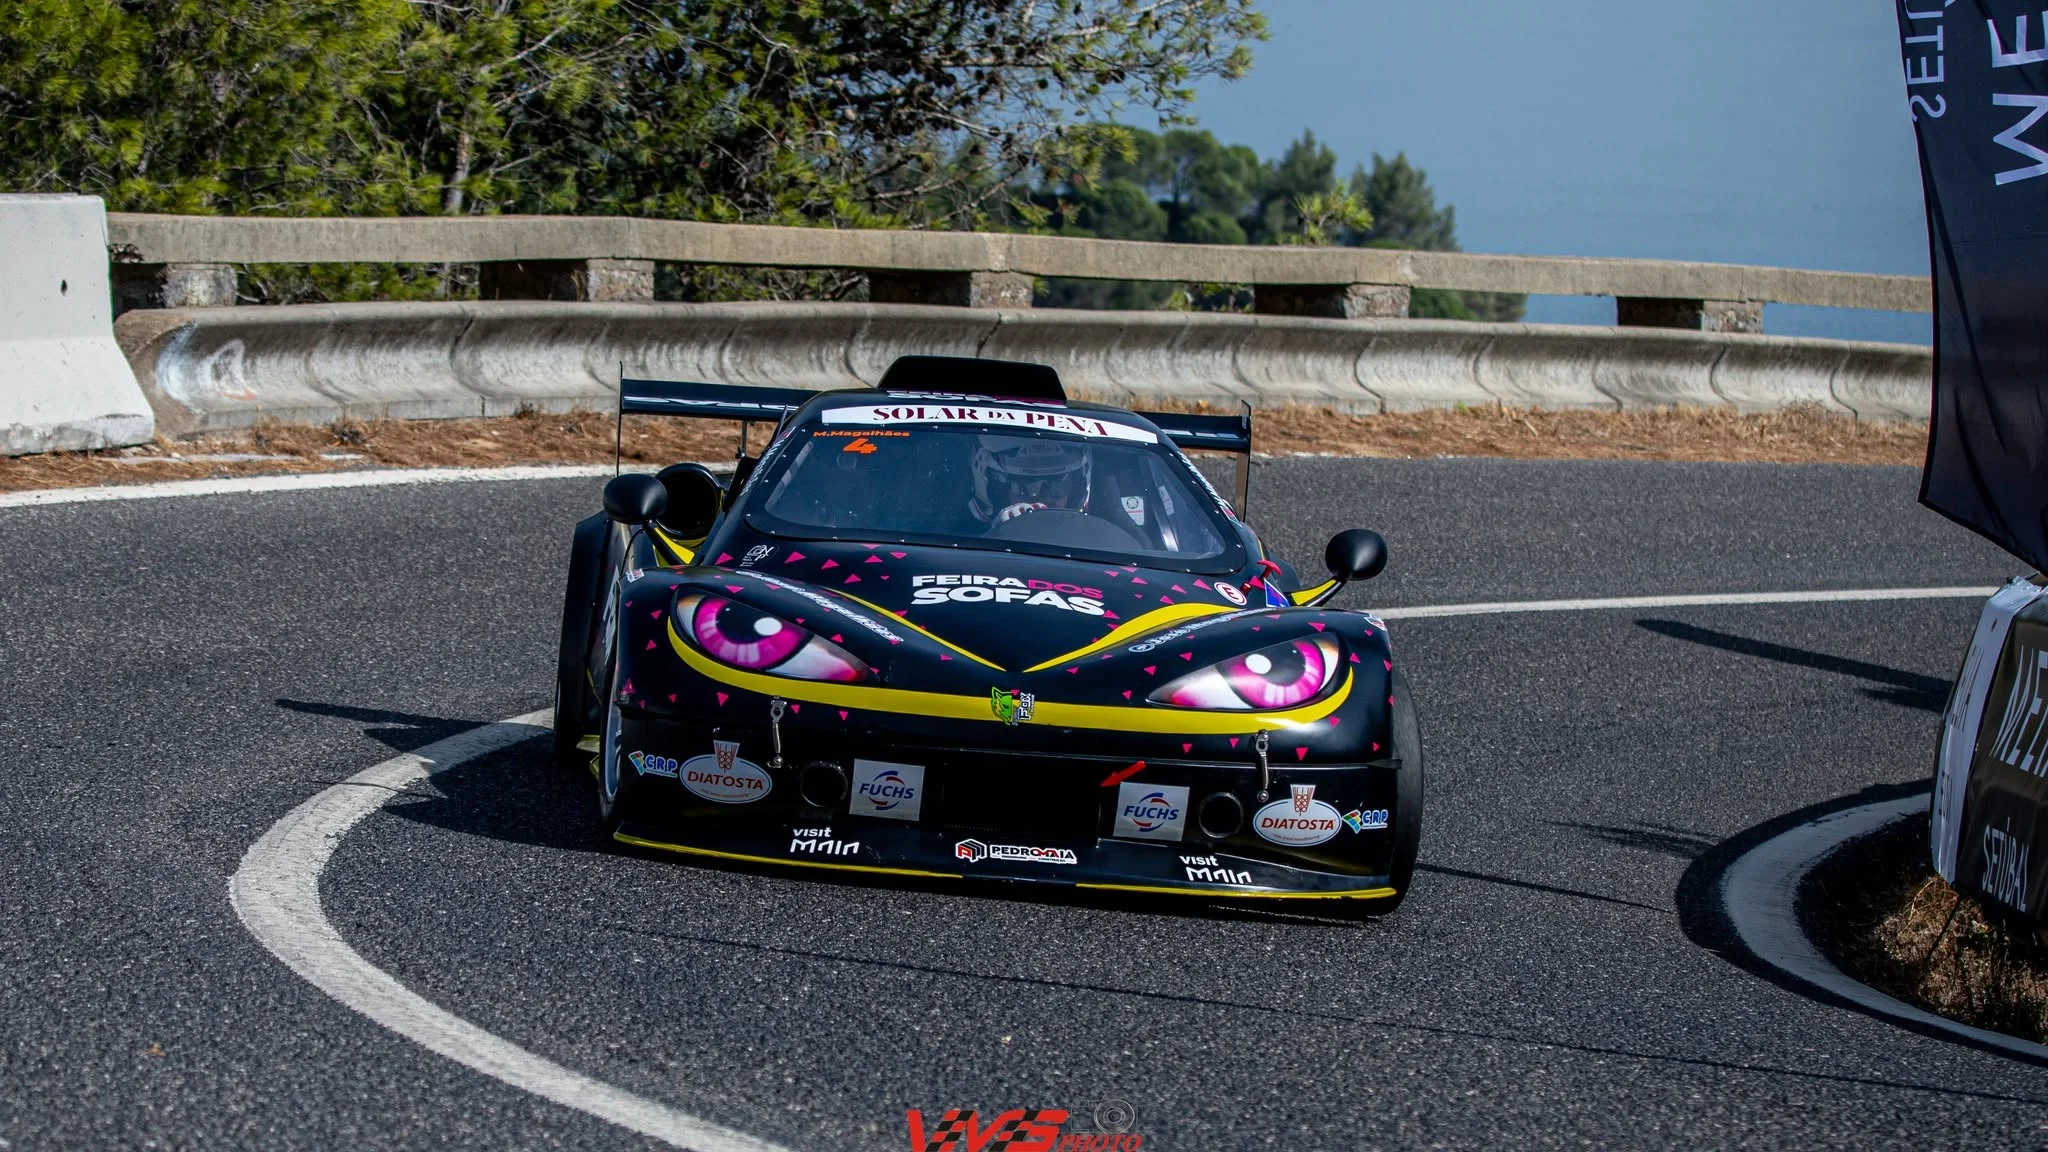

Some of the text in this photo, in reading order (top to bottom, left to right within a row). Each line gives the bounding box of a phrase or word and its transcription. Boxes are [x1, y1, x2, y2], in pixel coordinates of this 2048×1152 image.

[873, 407, 1109, 437] SOLAR DA PENA
[842, 437, 878, 454] 4
[645, 754, 678, 774] CRP
[686, 769, 765, 791] DIATOSTA
[858, 782, 915, 800] FUCHS
[1123, 804, 1180, 821] FUCHS
[1362, 809, 1389, 825] CRP
[792, 826, 832, 838] visit
[1260, 816, 1335, 832] DIATOSTA
[1179, 854, 1219, 868] visit
